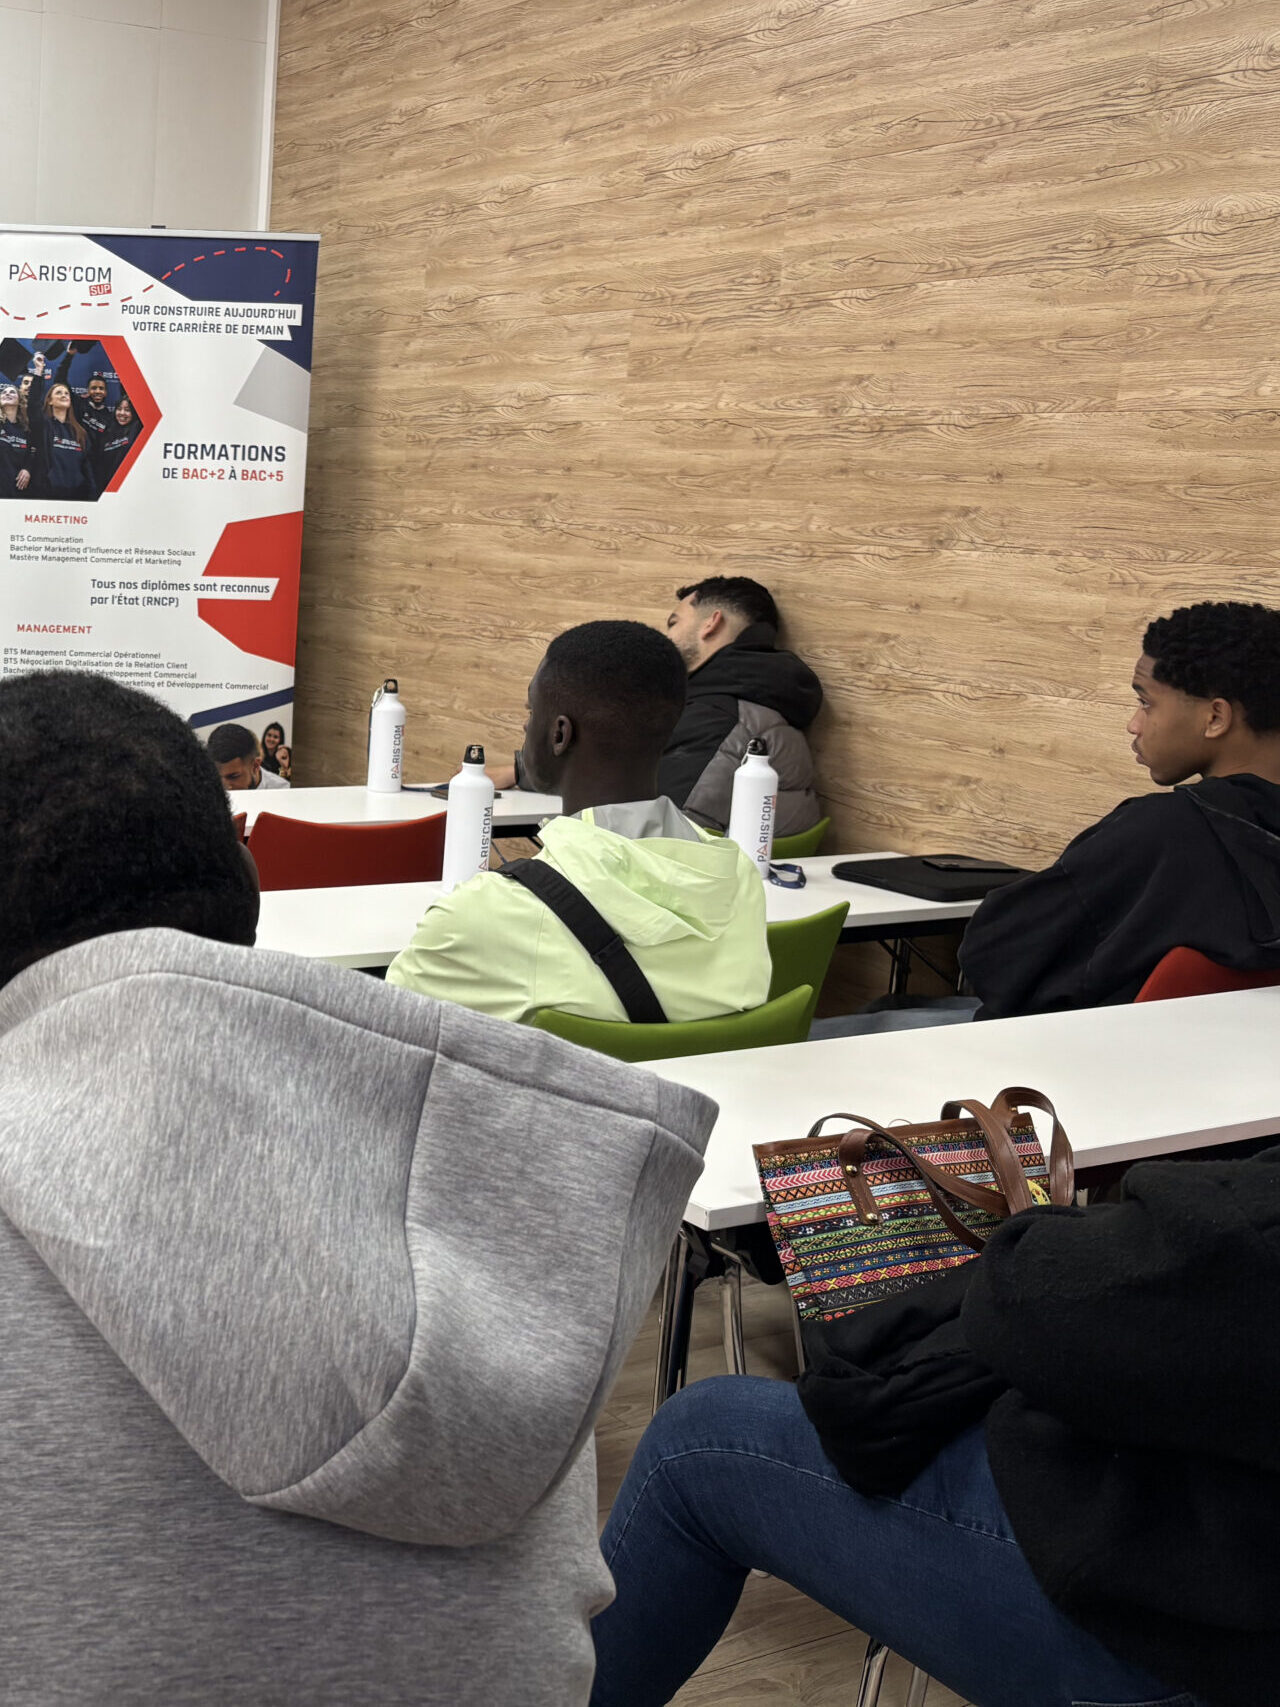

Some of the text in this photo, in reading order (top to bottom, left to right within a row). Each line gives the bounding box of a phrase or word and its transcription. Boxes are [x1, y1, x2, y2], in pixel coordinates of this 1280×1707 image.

[9, 263, 111, 283] PARIS'COM
[90, 285, 111, 296] SUP
[121, 304, 296, 319] POUR CONSTRUIRE AUJOURD'HUI
[133, 321, 284, 335] VOTRE CARRIÈRE DE DEMAIN
[164, 443, 285, 462] FORMATIONS
[162, 466, 283, 482] DE BAC+2 À BAC+5
[25, 515, 88, 524] MARKETING
[10, 534, 84, 543] BTS Communication
[10, 544, 42, 552] Bachelor
[44, 545, 81, 554] Marketing
[167, 548, 195, 556] Sociaux
[41, 555, 88, 563] Management
[90, 556, 134, 564] Commercial
[145, 558, 181, 566] Marketing
[91, 579, 270, 593] Tous nos diplômes sont reconnus
[90, 593, 179, 607] par l'État (RNCP)
[17, 624, 91, 634] MANAGEMENT
[20, 649, 66, 657] Management
[69, 650, 112, 658] Commercial
[113, 651, 161, 659] Opérationnel
[3, 657, 18, 665] BTS
[20, 658, 63, 666] Négociation
[65, 659, 113, 667] Digitalisation
[134, 661, 165, 669] Relation
[153, 671, 197, 679] Commercial
[156, 680, 165, 688] et
[166, 680, 224, 689] Développement
[225, 682, 269, 690] Commercial
[757, 795, 773, 862] PARIS'COM
[479, 807, 493, 871] ARIS'COM
